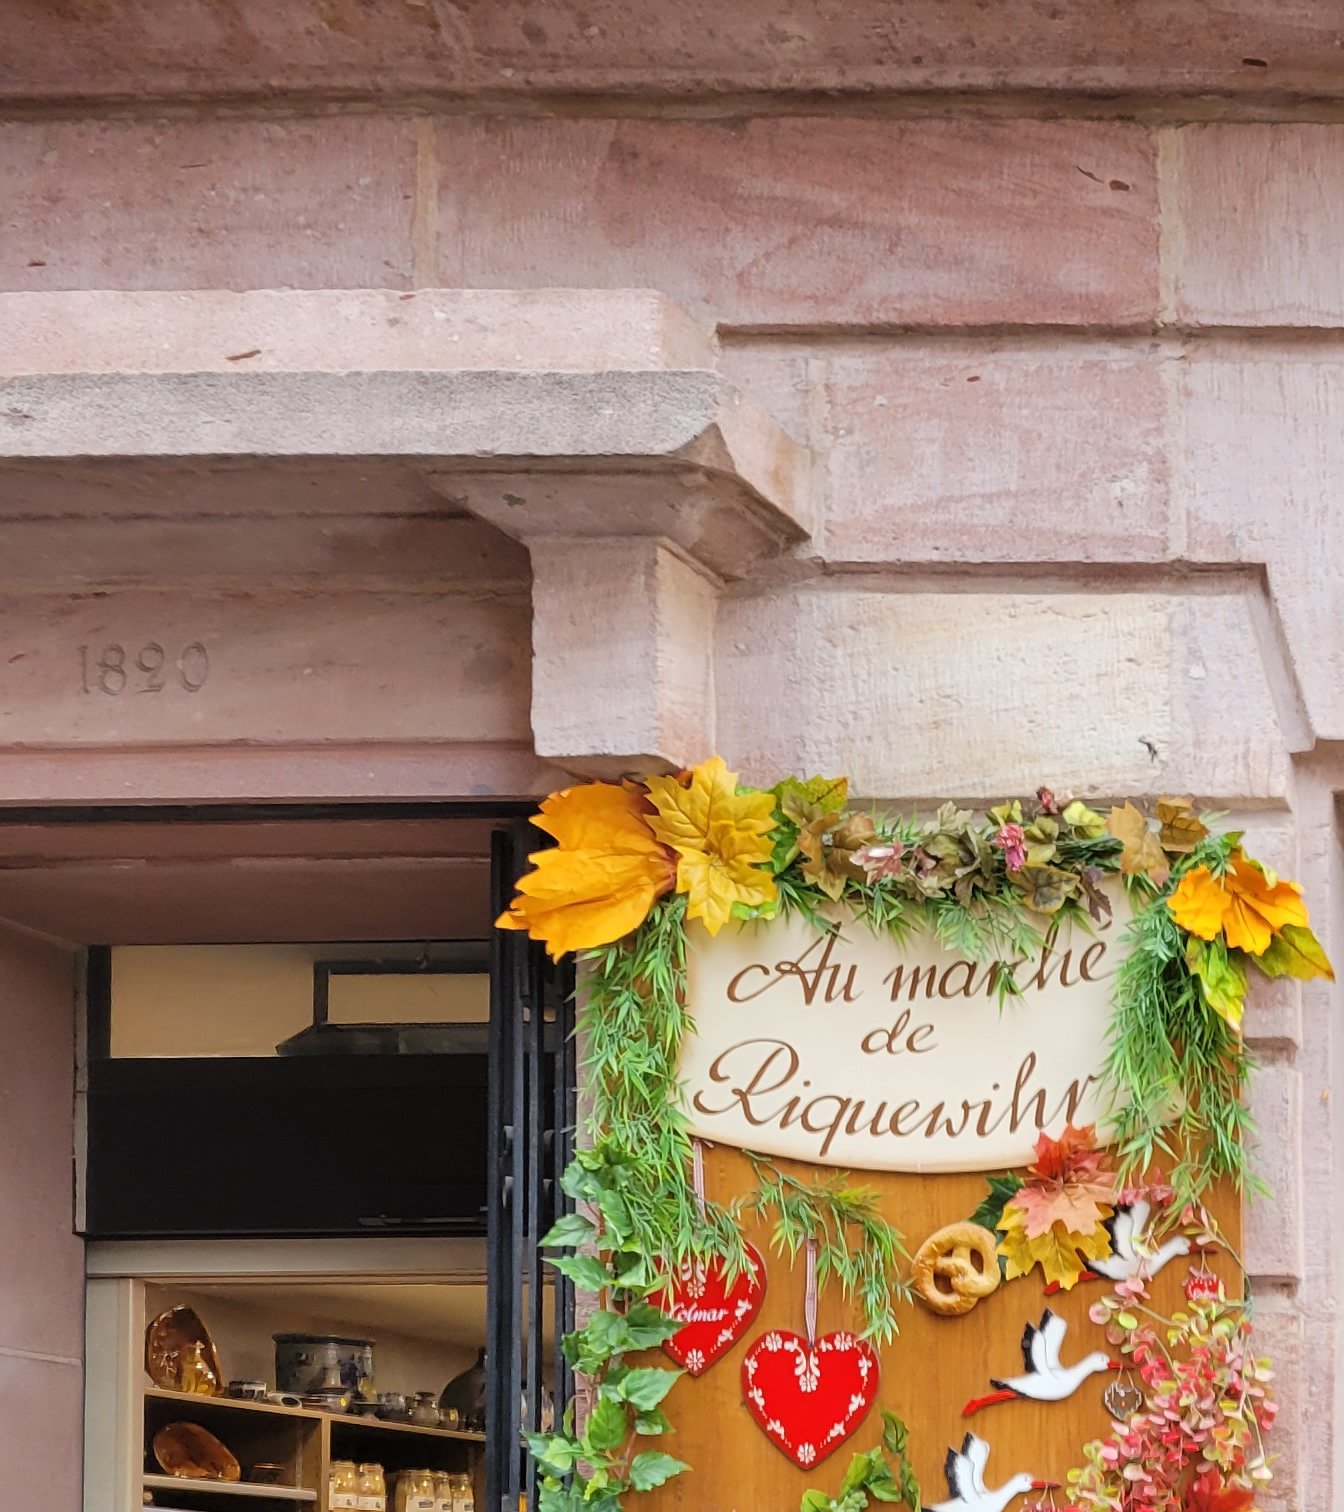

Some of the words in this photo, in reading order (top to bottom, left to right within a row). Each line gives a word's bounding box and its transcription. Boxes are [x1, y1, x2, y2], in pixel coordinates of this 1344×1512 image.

[727, 921, 863, 1005] Au
[883, 918, 1117, 1002] marché
[861, 1008, 939, 1054] de
[693, 1038, 1104, 1157] Riquewihr
[668, 1301, 729, 1323] Colmar
